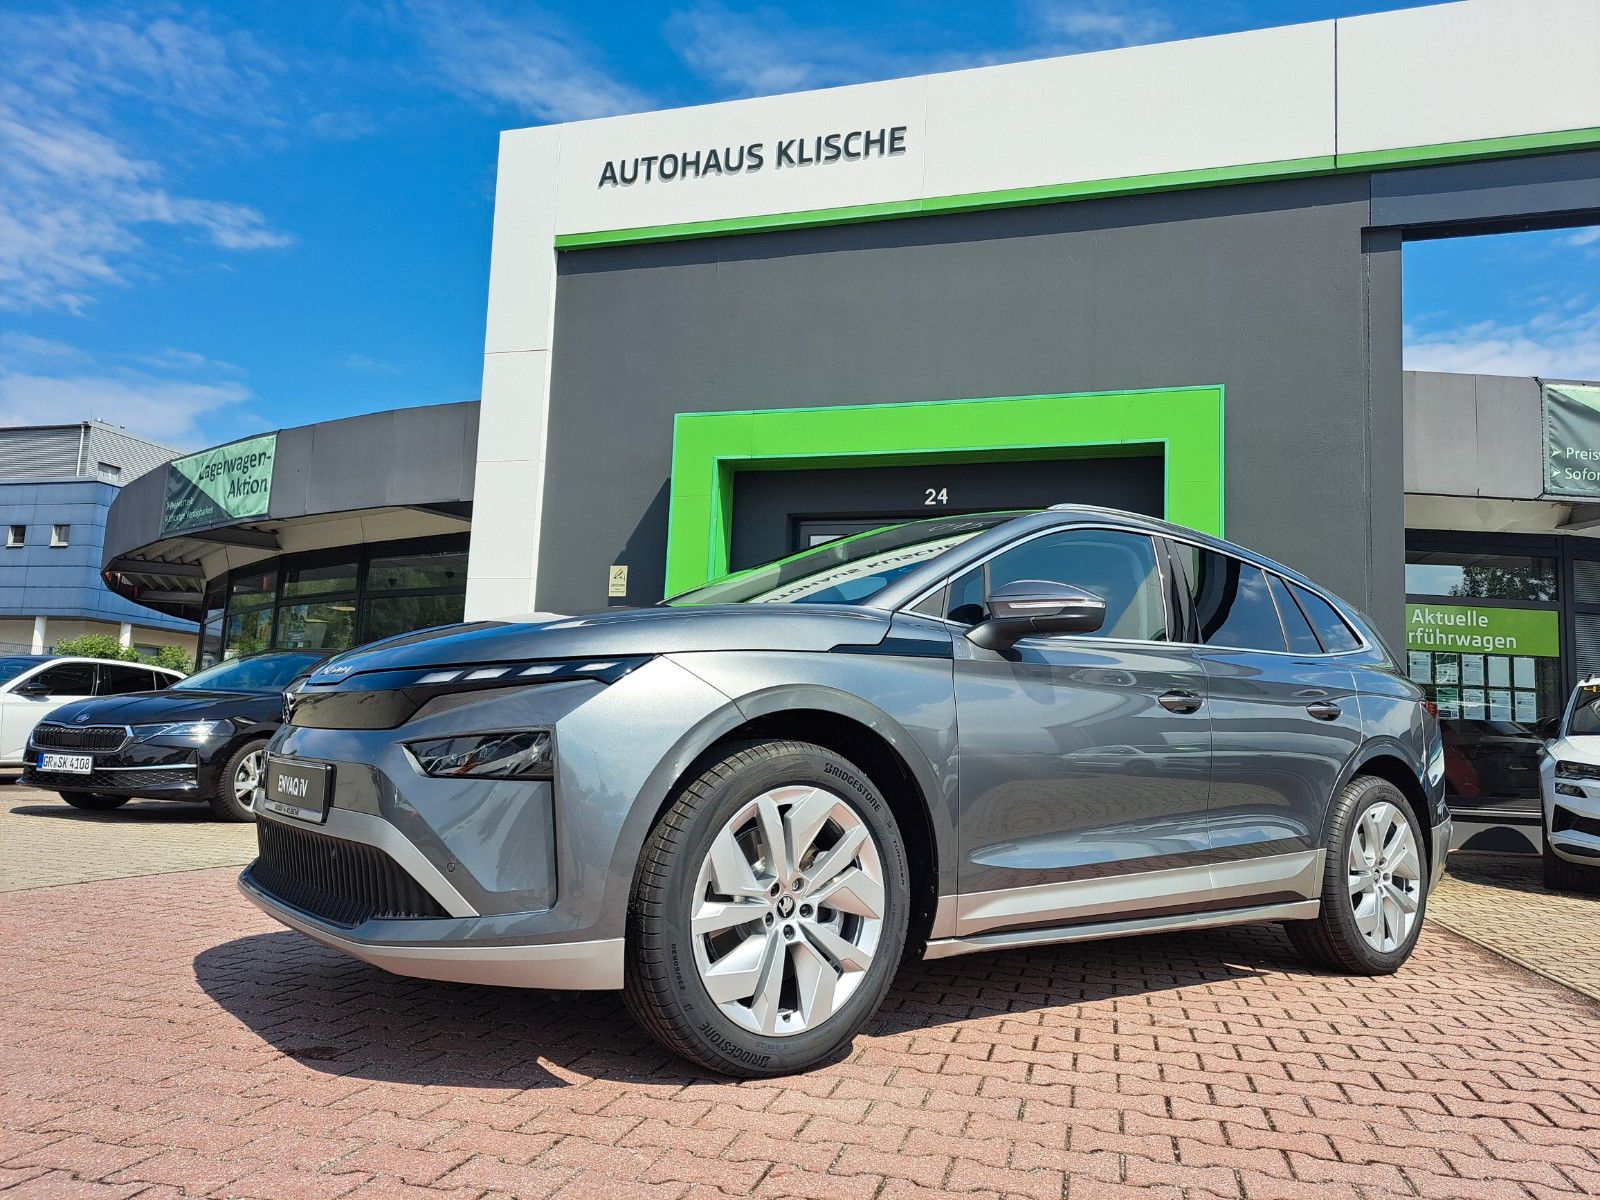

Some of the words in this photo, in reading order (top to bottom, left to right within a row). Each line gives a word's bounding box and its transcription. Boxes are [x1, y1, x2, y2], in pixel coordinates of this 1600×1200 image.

[599, 143, 764, 189] AUTOHAUS
[776, 126, 907, 168] KLISCHE
[199, 451, 271, 482] Lagerwagen-
[227, 475, 268, 499] Aktion
[925, 488, 948, 505] 24
[1411, 608, 1489, 627] Aktuelle
[43, 755, 54, 768] GR
[57, 756, 68, 769] SK
[69, 758, 90, 770] 4108
[823, 762, 882, 813] BRIDGESTONE
[698, 1021, 771, 1069] BRIDGESTONE
